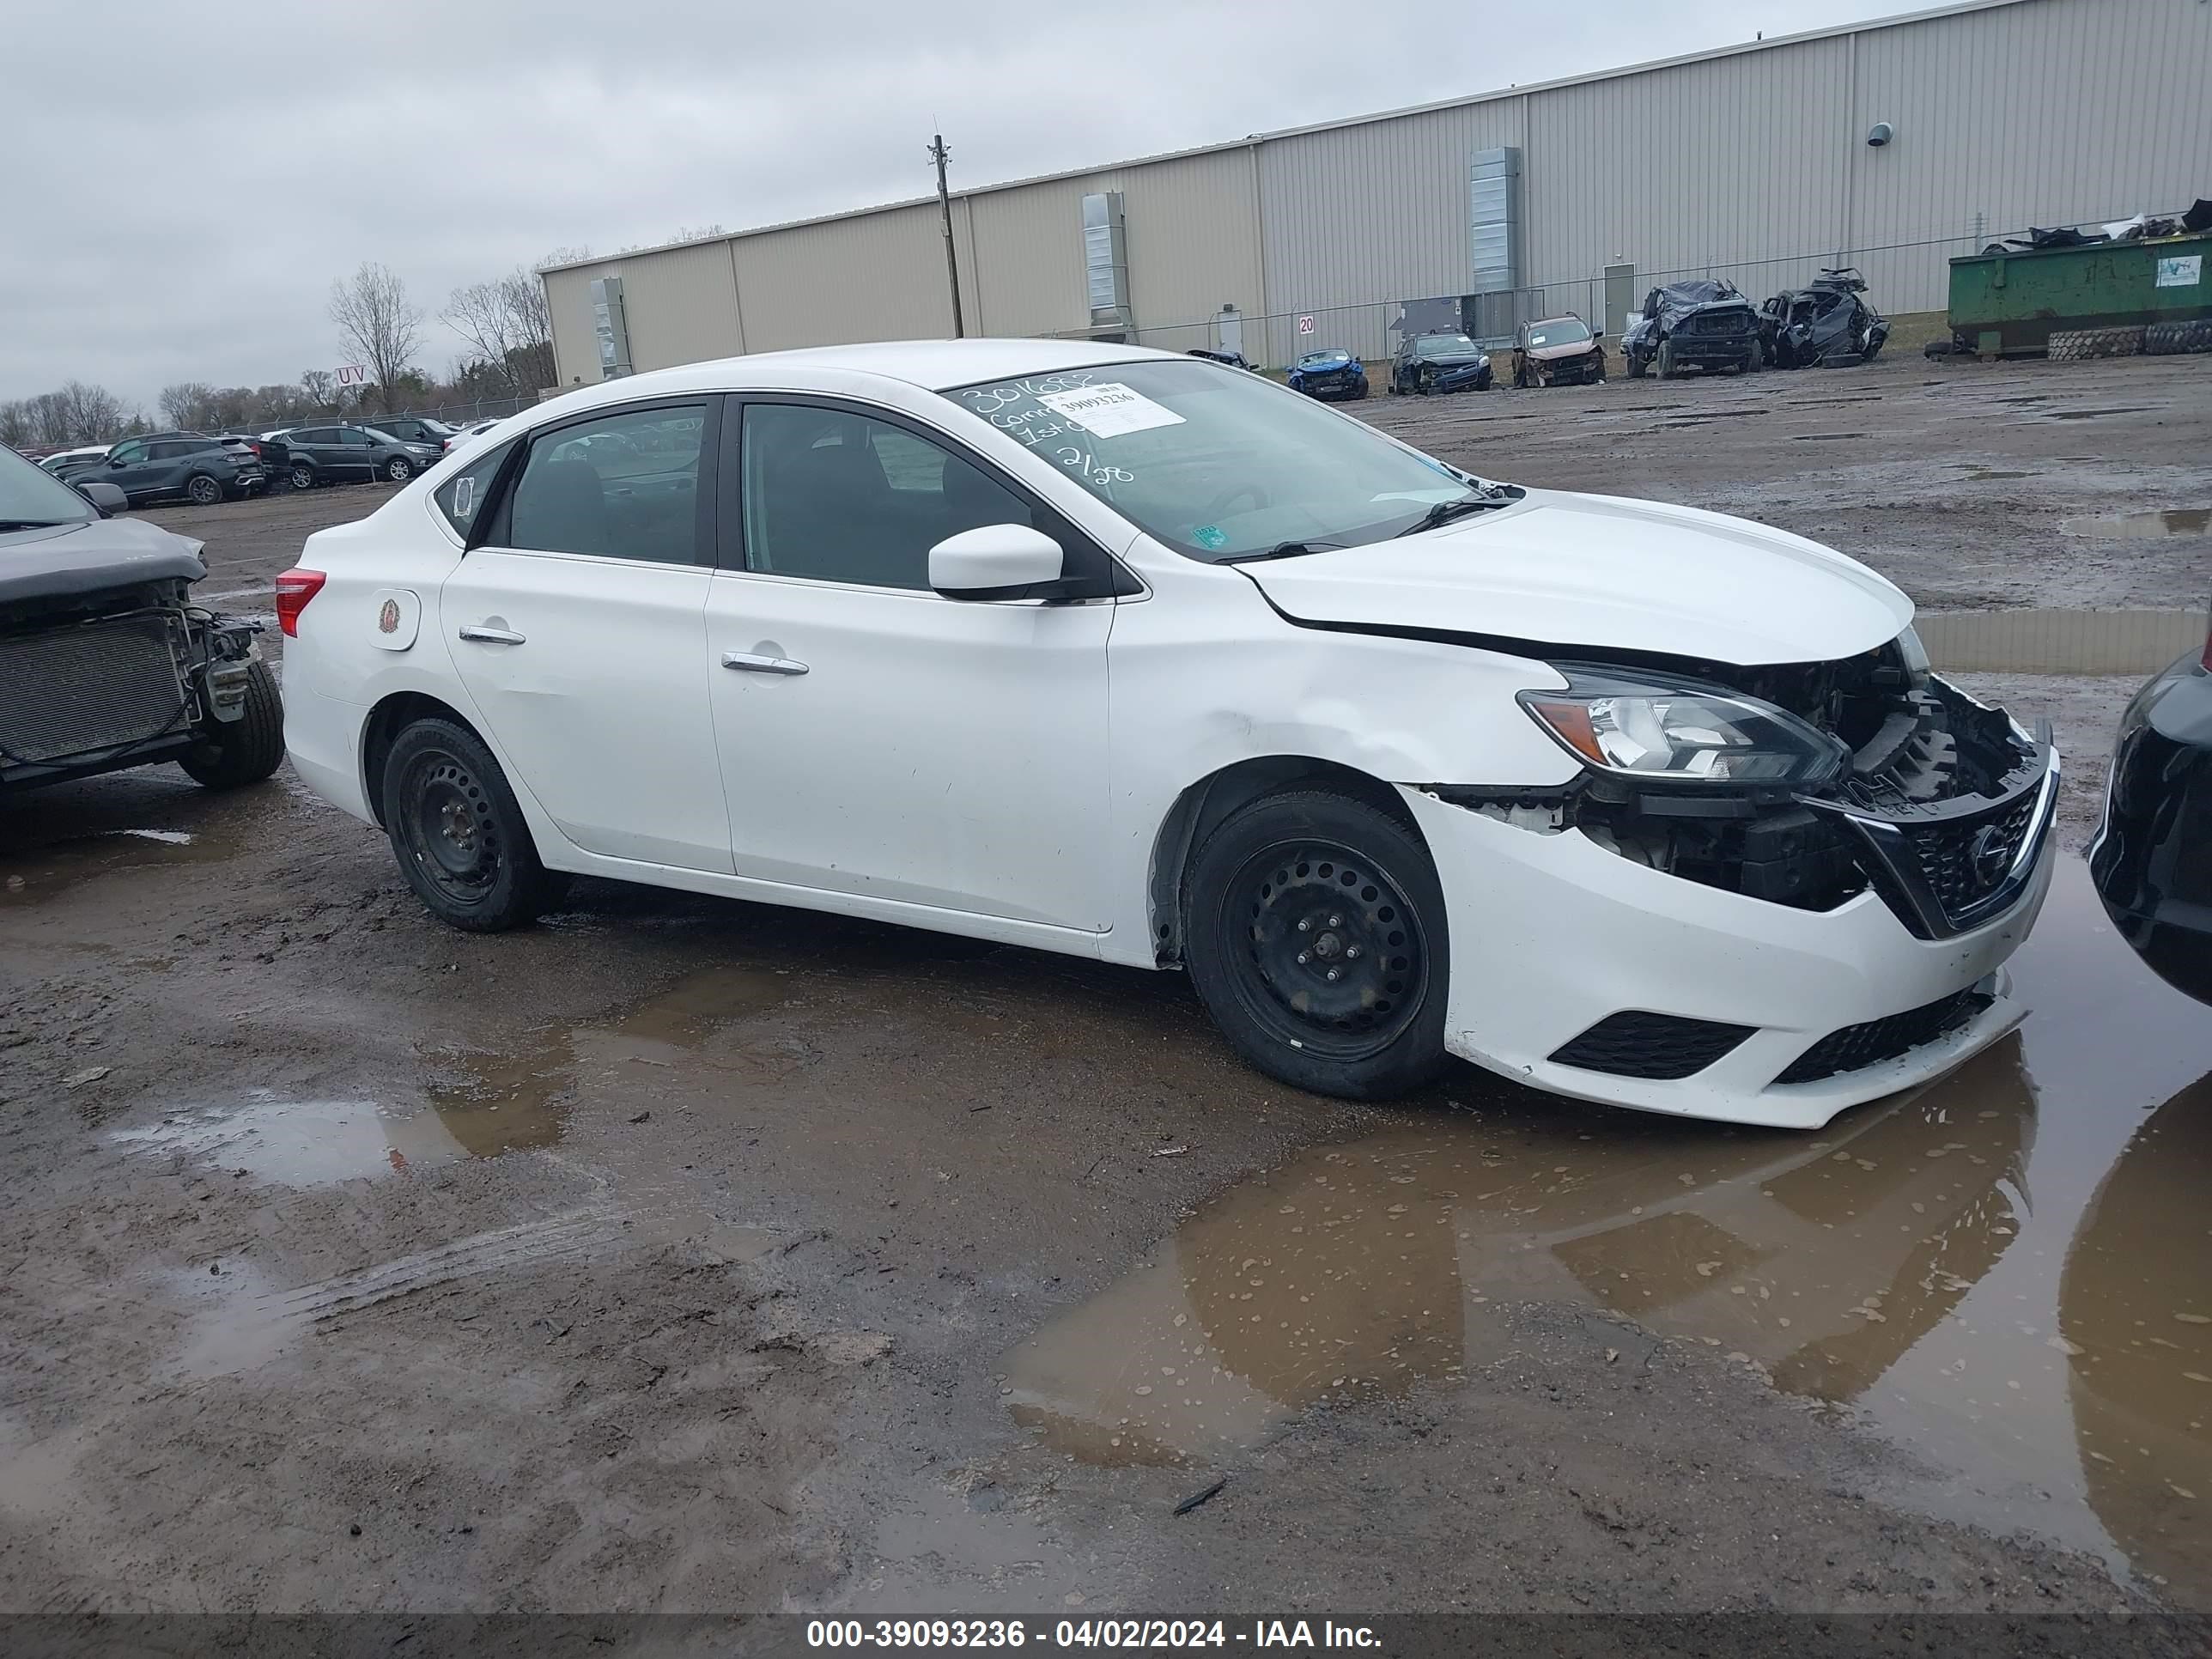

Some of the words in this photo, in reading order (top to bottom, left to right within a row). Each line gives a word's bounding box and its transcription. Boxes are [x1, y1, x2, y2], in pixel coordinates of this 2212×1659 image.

[1301, 318, 1313, 332] 20
[338, 367, 364, 384] UV
[1061, 392, 1135, 412] 39093236
[1056, 447, 1134, 485] 2/28
